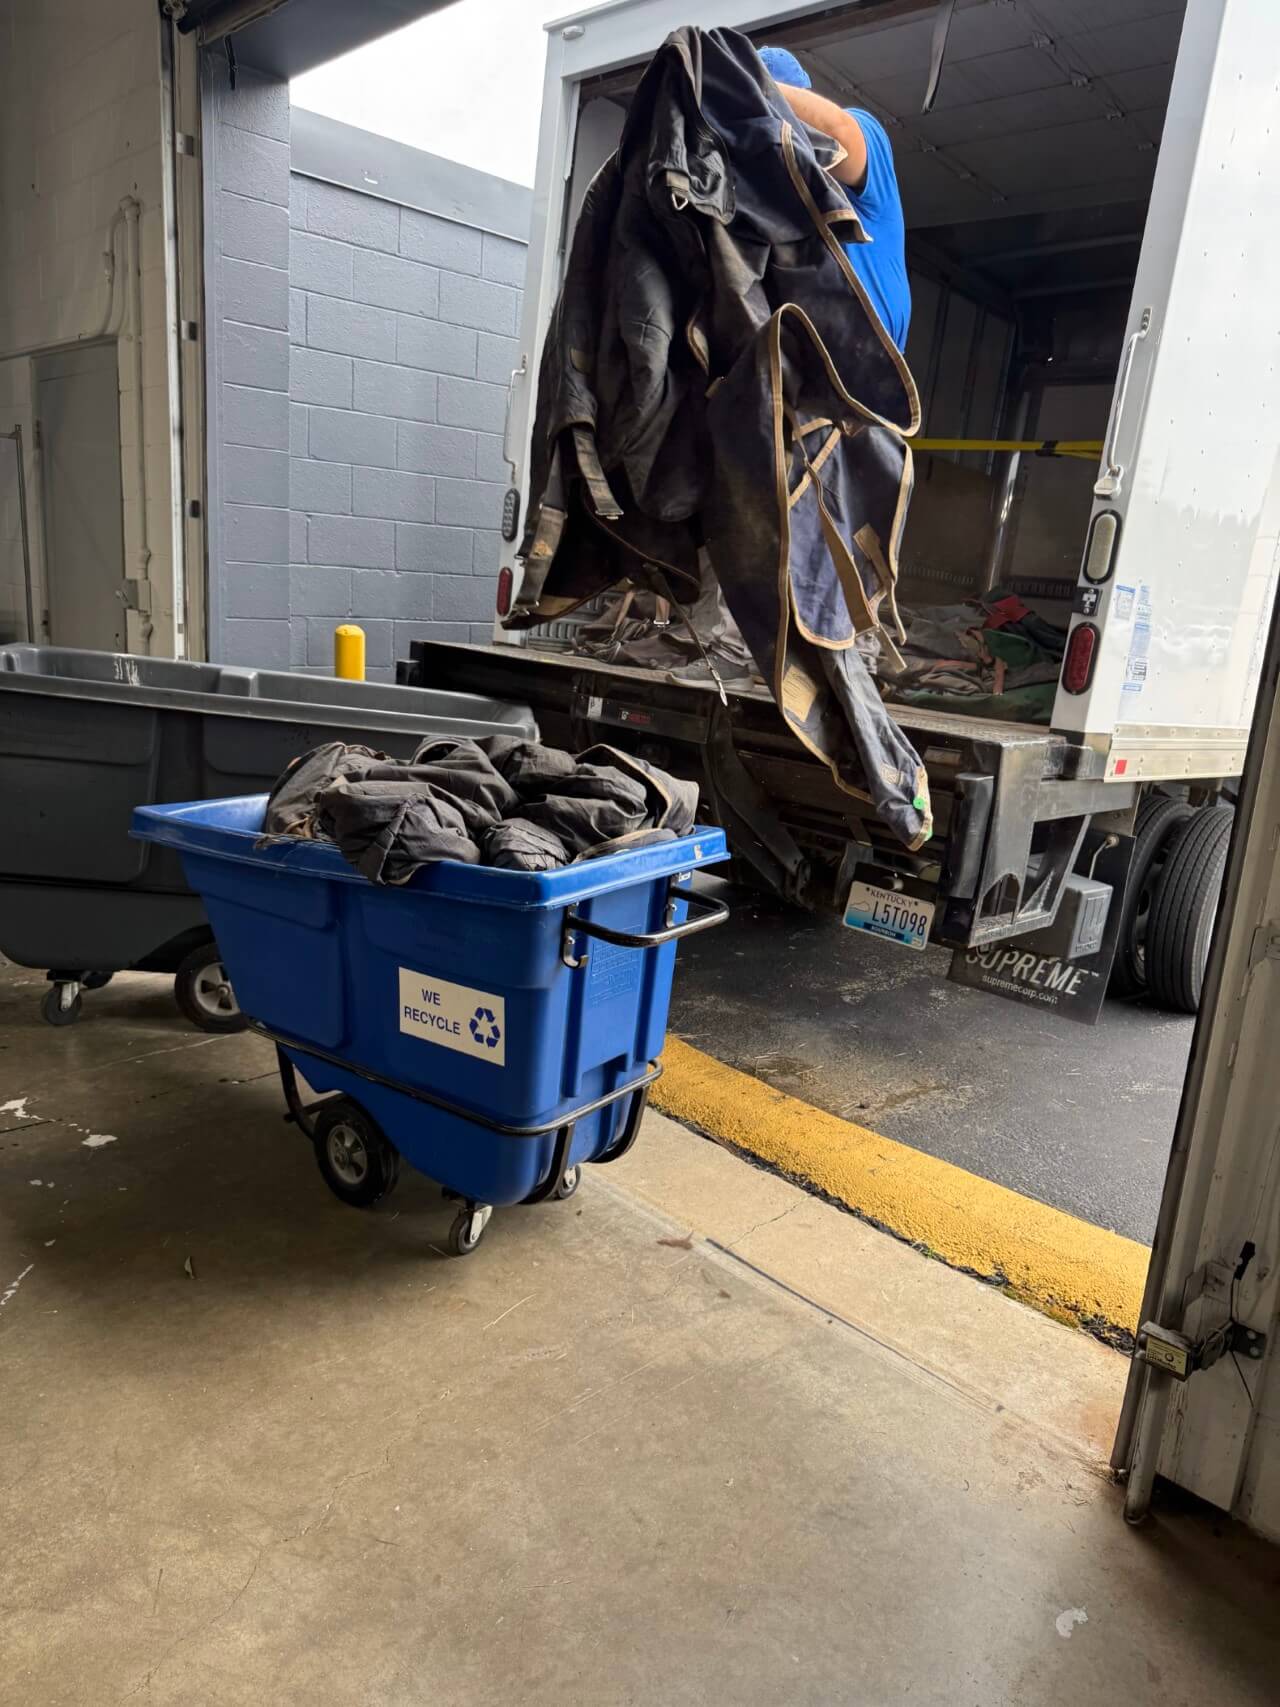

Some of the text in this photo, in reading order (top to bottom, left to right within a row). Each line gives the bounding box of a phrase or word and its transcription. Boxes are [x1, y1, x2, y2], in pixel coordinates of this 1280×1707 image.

[870, 889, 912, 907] KENTUCKY
[871, 901, 927, 936] L5T098
[421, 988, 441, 1006] WE
[982, 974, 1058, 1004] supremecorp.com
[403, 1005, 461, 1036] RECYCLE
